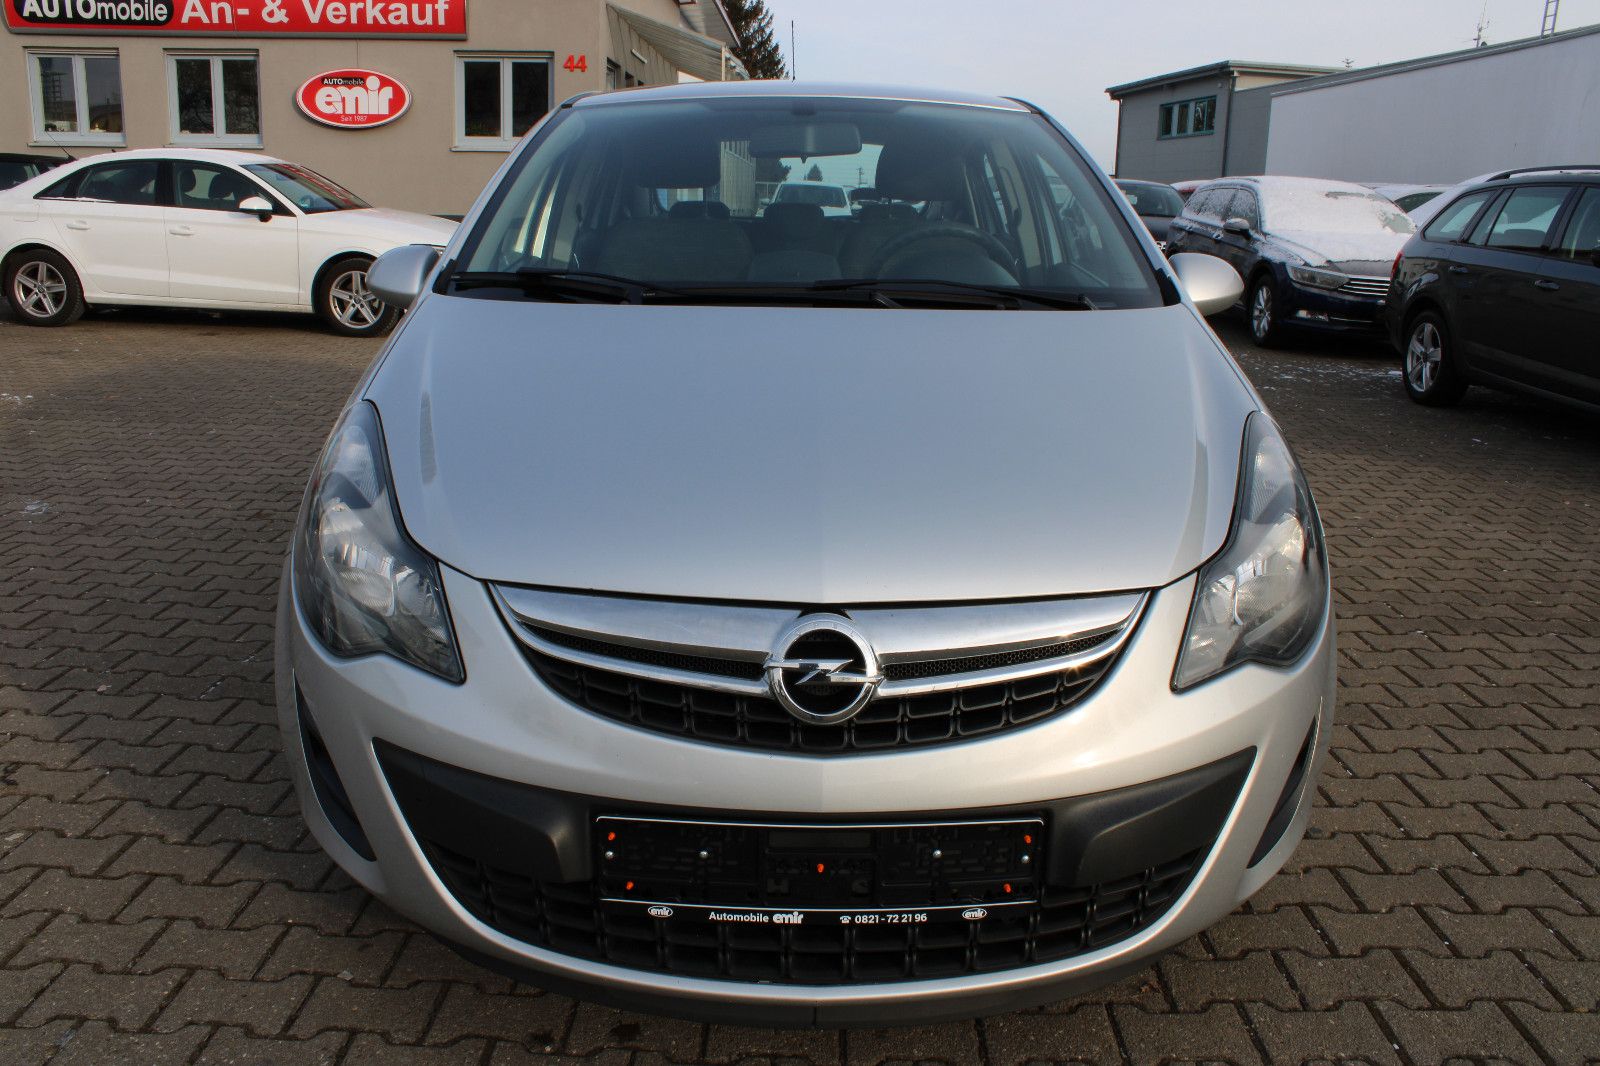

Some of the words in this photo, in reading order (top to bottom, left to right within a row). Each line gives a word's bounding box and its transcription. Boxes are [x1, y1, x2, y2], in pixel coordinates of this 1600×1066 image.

[22, 0, 168, 21] AUTOmobile
[181, 0, 250, 24] An-
[261, 0, 290, 24] &
[302, 0, 449, 26] Verkauf
[563, 54, 588, 72] 44
[323, 78, 364, 86] AUTOmobile
[315, 76, 393, 115] emir
[708, 911, 770, 923] Automobile
[772, 911, 804, 924] emir
